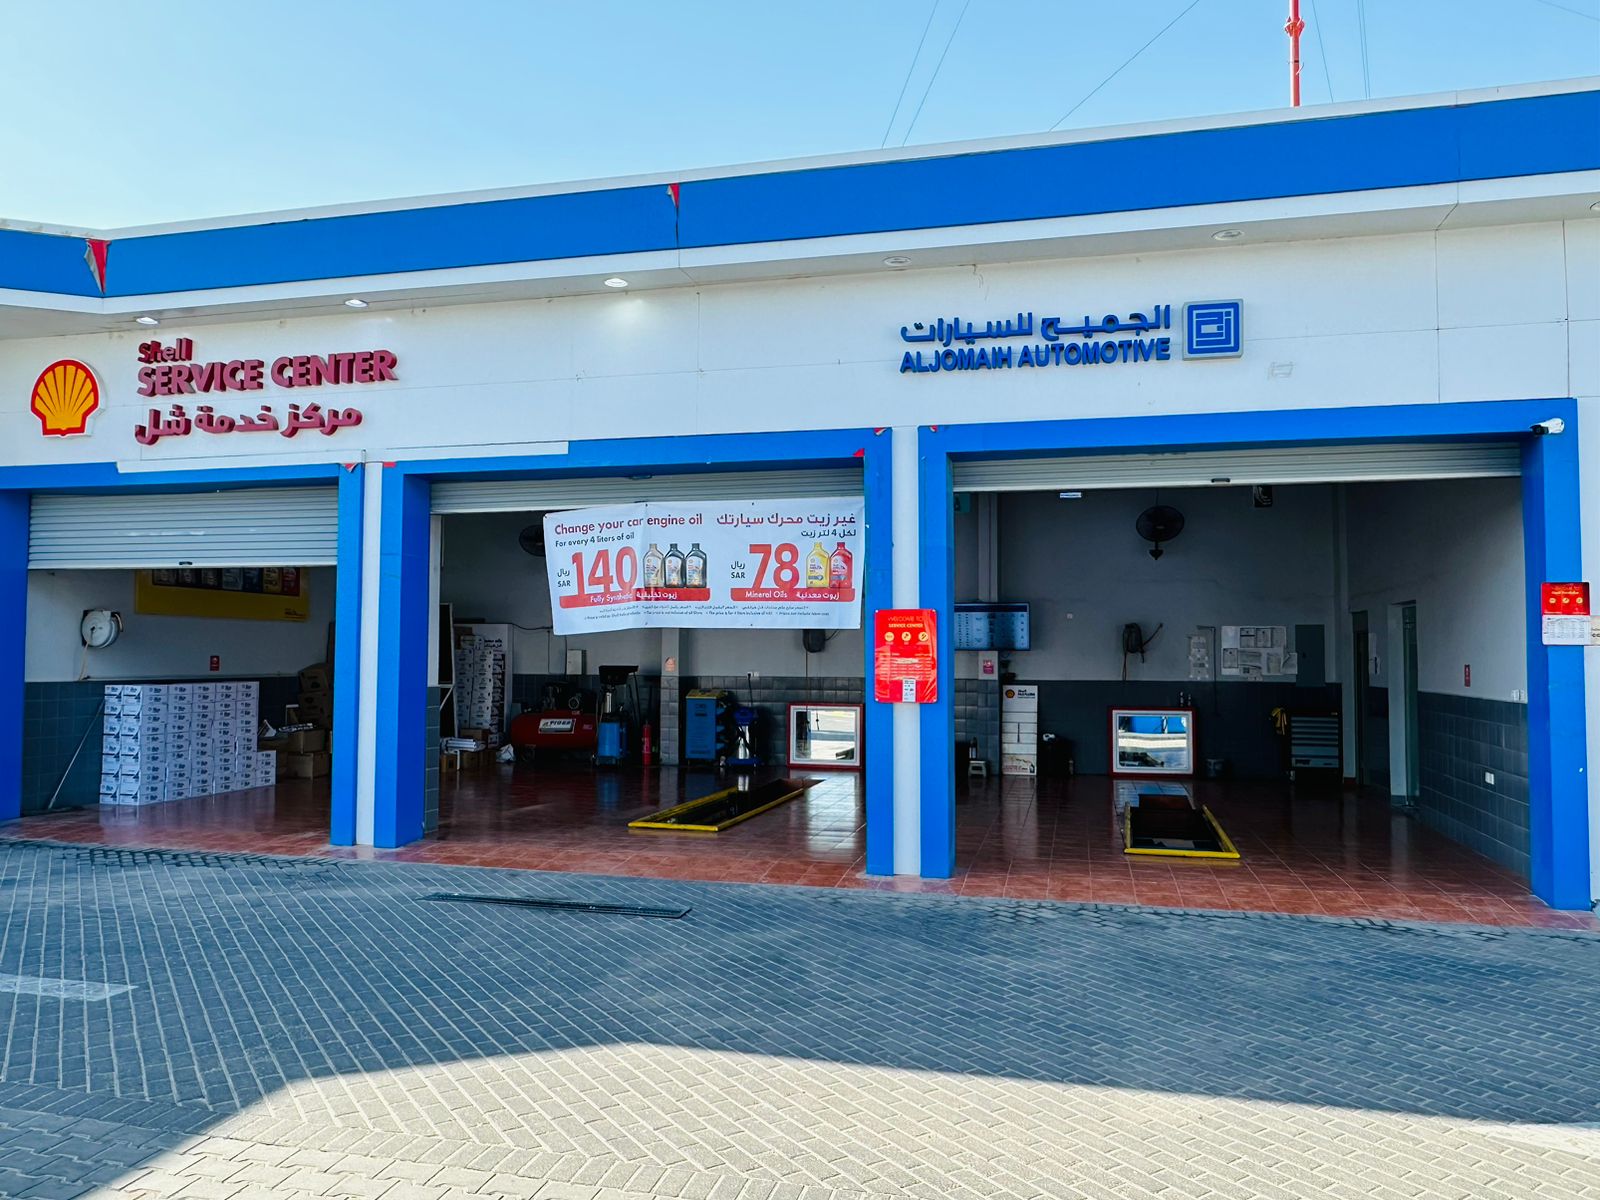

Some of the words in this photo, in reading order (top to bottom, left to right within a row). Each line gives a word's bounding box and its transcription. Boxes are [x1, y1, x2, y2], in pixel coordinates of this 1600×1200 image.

[900, 312, 1033, 347] للسيارات
[1041, 304, 1171, 341] الجميح
[137, 337, 193, 364] Shell
[899, 345, 1013, 374] ALJOMAIH
[1017, 337, 1171, 369] AUTOMOTIVE
[136, 359, 264, 398] SERVICE
[270, 349, 400, 389] CENTER
[134, 403, 192, 446] شل
[194, 404, 279, 434] خدمة
[280, 401, 363, 438] مركز
[554, 522, 595, 535] Change
[598, 520, 625, 533] your
[627, 517, 644, 527] car
[646, 514, 685, 528] engine
[688, 513, 703, 525] oil
[716, 513, 764, 528] سيارتك
[767, 513, 803, 527] محرك
[807, 513, 830, 527] زيت
[833, 513, 856, 527] غير
[568, 537, 589, 546] every
[590, 536, 595, 544] 4
[596, 534, 615, 543] liters
[616, 533, 624, 541] of
[625, 531, 635, 540] oil
[800, 529, 816, 538] زيت
[818, 529, 830, 538] لتر
[831, 529, 837, 537] 4
[838, 529, 856, 538] لكل
[571, 546, 638, 594] 140
[730, 560, 746, 570] ريال
[749, 542, 799, 589] 78
[557, 568, 570, 578] ريال
[730, 571, 746, 579] SAR
[557, 580, 571, 588] SAR
[590, 595, 604, 604] Fully
[662, 592, 677, 600] زيوت
[745, 590, 772, 598] Mineral
[773, 590, 788, 598] Oils
[823, 591, 840, 600] زيوت
